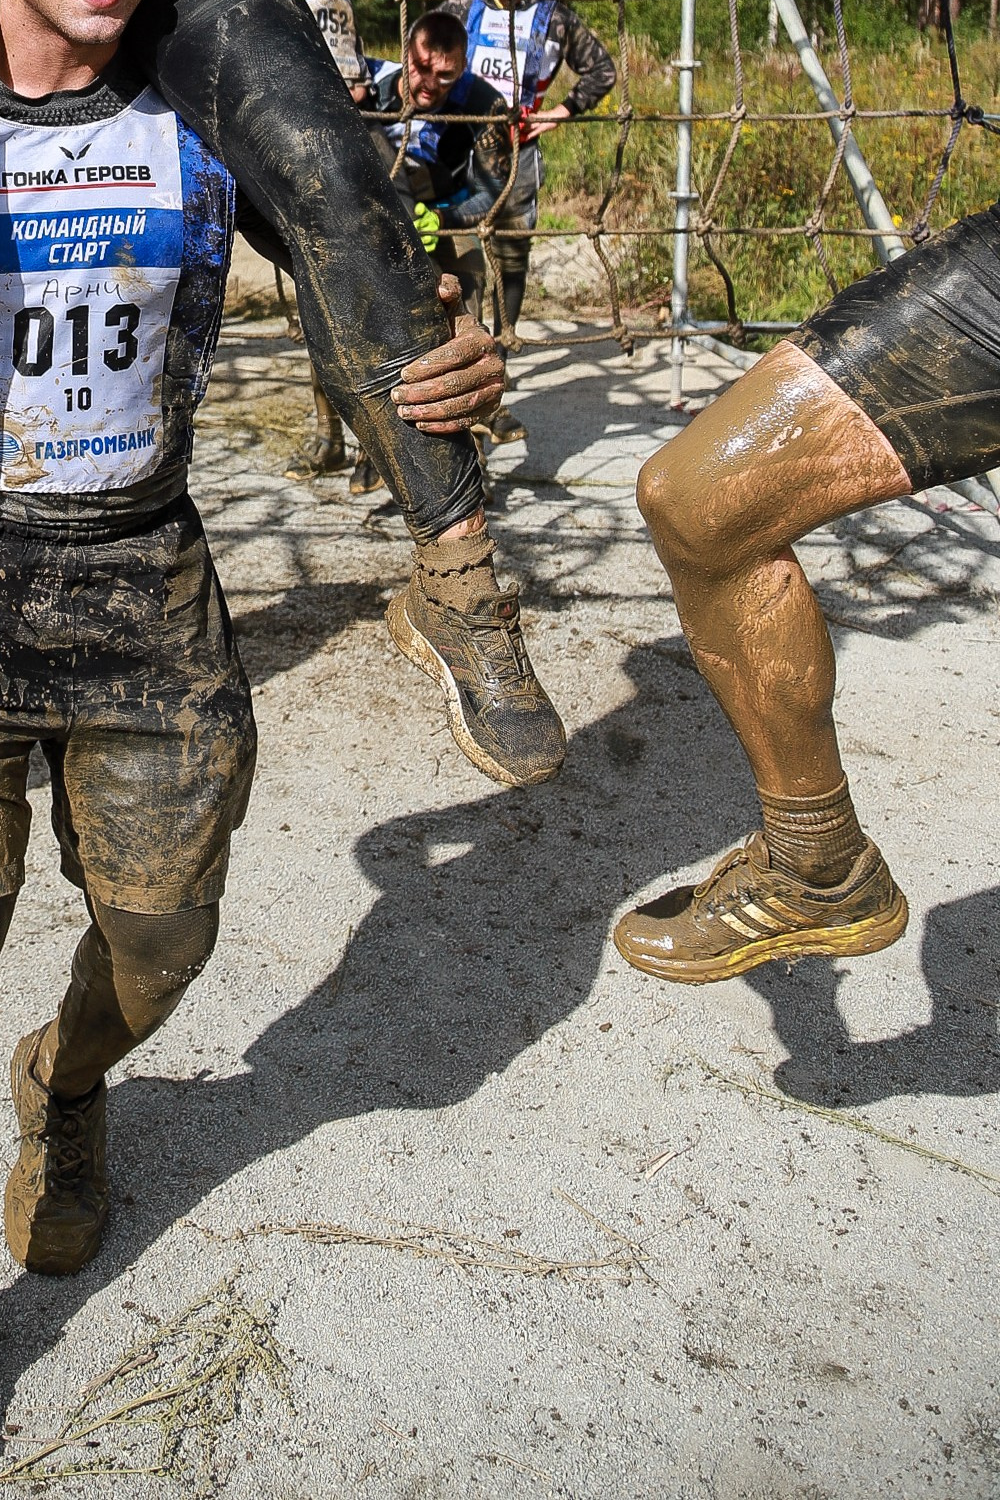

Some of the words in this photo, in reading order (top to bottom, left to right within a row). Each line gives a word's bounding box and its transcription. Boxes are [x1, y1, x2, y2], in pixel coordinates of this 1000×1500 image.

[316, 8, 350, 35] 052
[481, 57, 514, 79] 052
[1, 168, 68, 188] ГОНКА
[74, 165, 152, 183] ГЕРОЕВ
[11, 209, 147, 241] КОМАНДНЫЙ
[48, 240, 111, 264] СТАРТ
[12, 303, 142, 377] 013
[63, 387, 92, 412] 10
[35, 427, 157, 460] ГАЗПРОМБАНК
